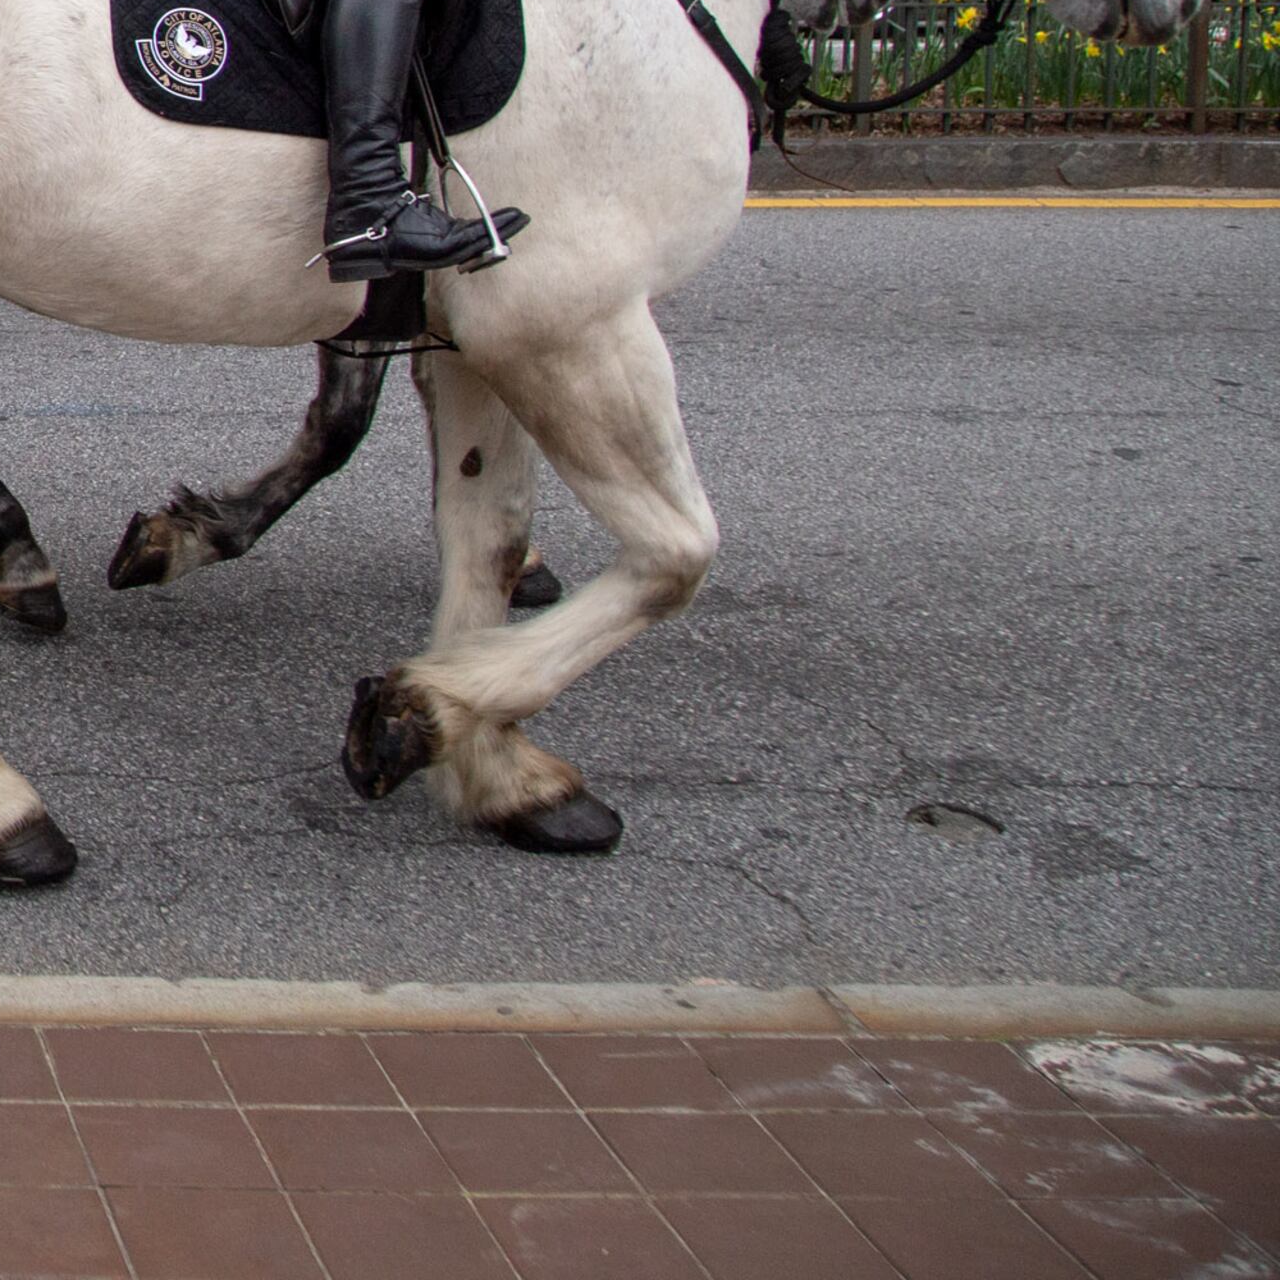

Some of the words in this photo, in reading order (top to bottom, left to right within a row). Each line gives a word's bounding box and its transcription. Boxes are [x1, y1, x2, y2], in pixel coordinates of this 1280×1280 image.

[158, 40, 203, 78] POLICE
[164, 12, 186, 26] CITY
[189, 12, 204, 22] OF
[203, 21, 224, 65] ATLANTA
